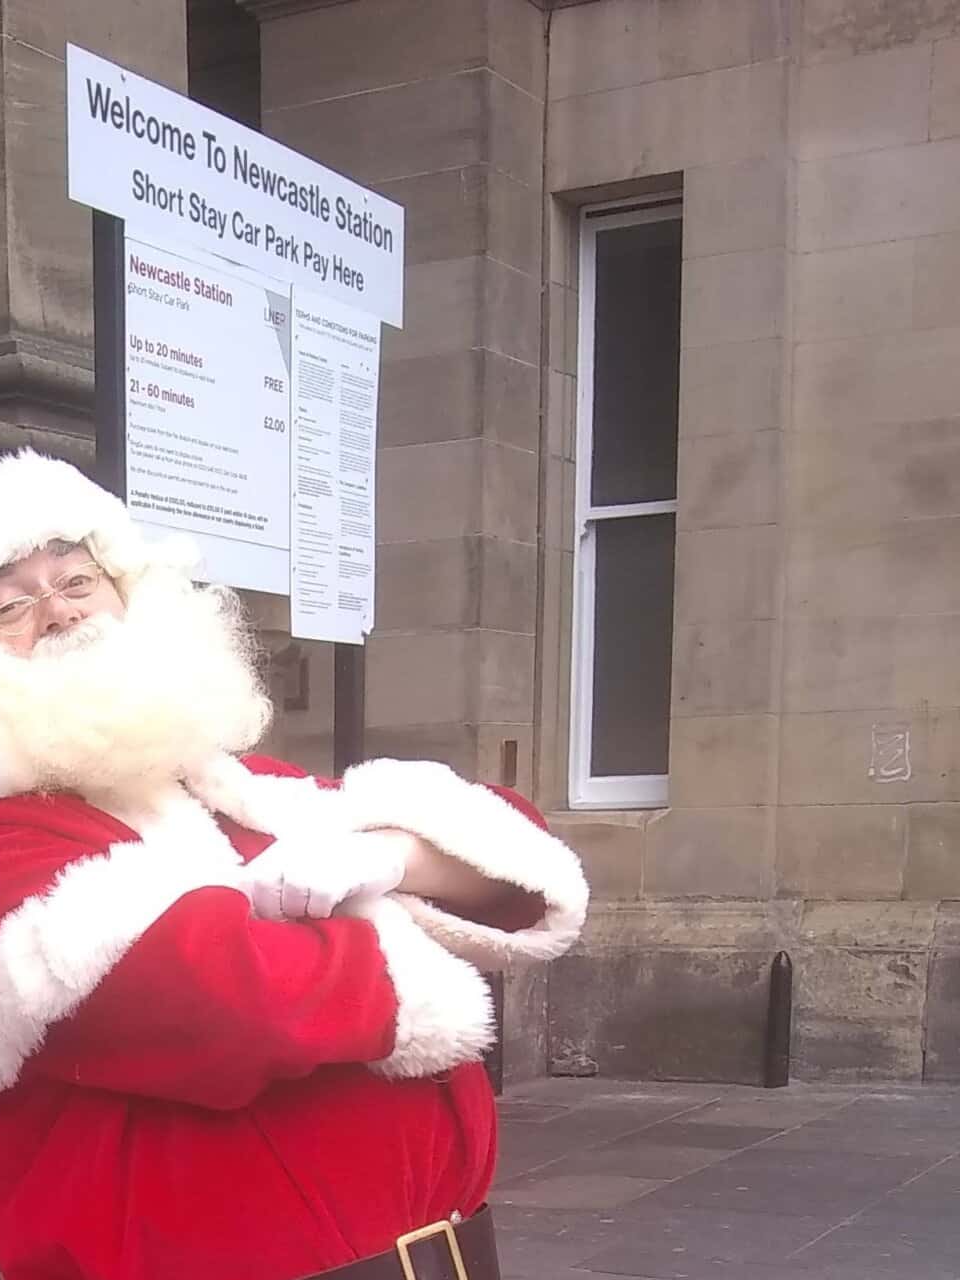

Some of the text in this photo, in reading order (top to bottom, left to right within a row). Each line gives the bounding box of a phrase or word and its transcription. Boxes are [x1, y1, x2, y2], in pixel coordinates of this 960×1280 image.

[86, 77, 394, 253] Welcome To Newcastle Station
[132, 169, 364, 293] Short Stay Car Park Pay Here
[129, 253, 233, 307] Newcastle Station
[129, 333, 203, 369] Up to 20 minutes
[129, 378, 140, 393] 21
[147, 383, 160, 399] 60
[161, 388, 195, 409] minutes
[263, 376, 284, 393] FREE
[263, 416, 286, 433] £2.00
